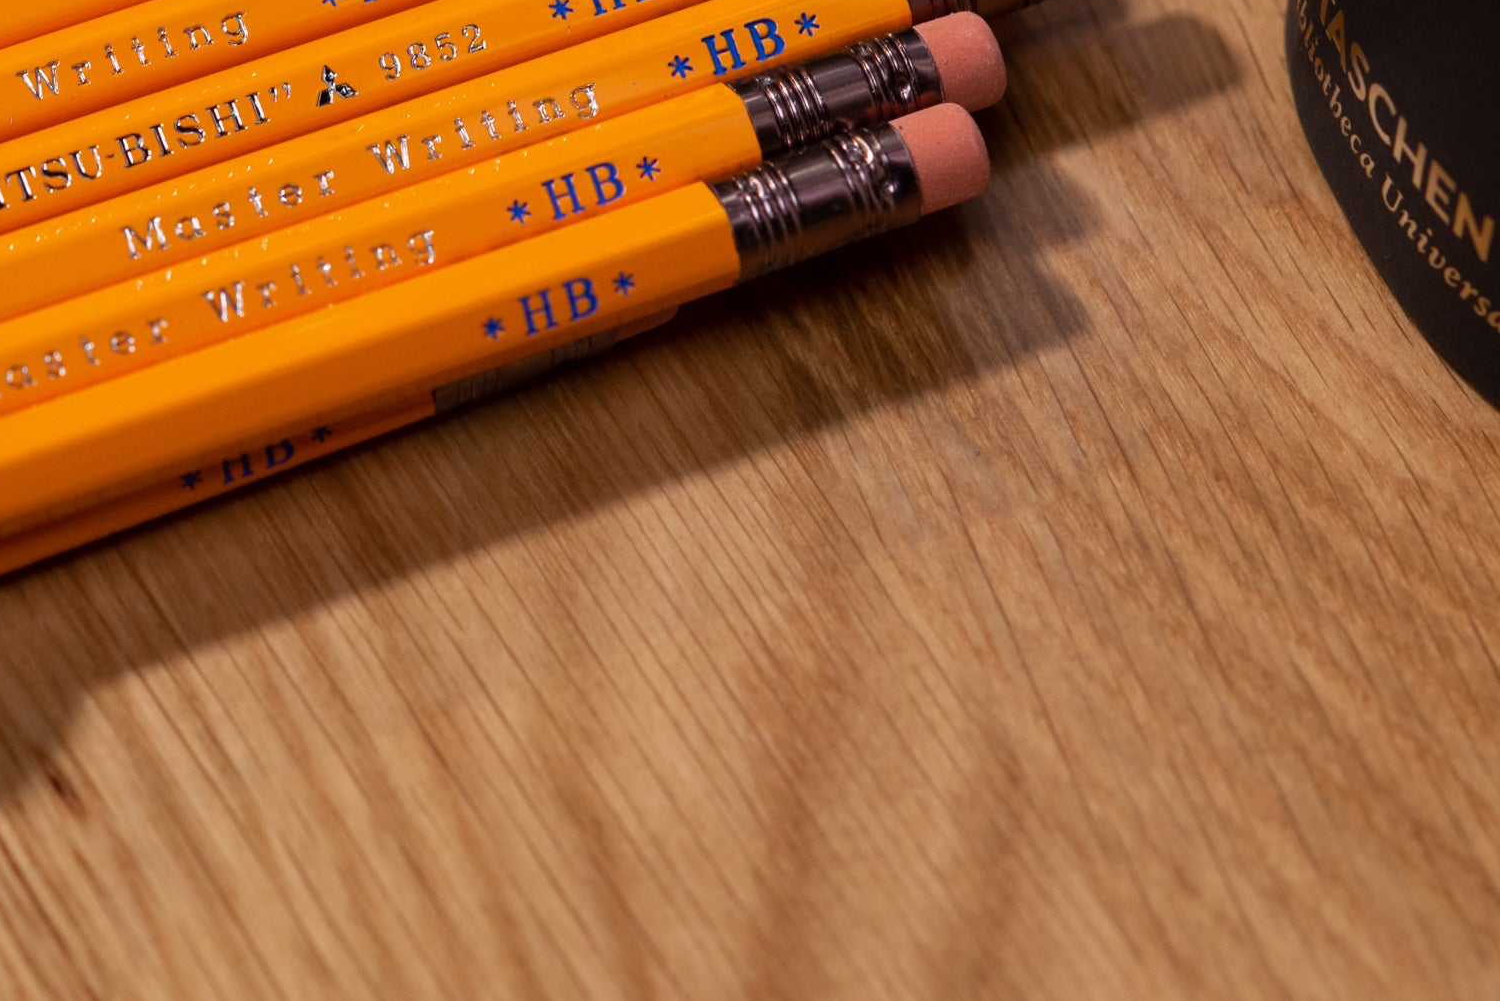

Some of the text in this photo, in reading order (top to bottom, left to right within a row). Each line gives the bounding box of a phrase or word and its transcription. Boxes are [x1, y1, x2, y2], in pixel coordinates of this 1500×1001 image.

[14, 8, 251, 101] Writing
[376, 23, 489, 82] 9852
[118, 169, 337, 261] Master
[365, 81, 601, 176] Writing
[201, 229, 435, 324] Writing
